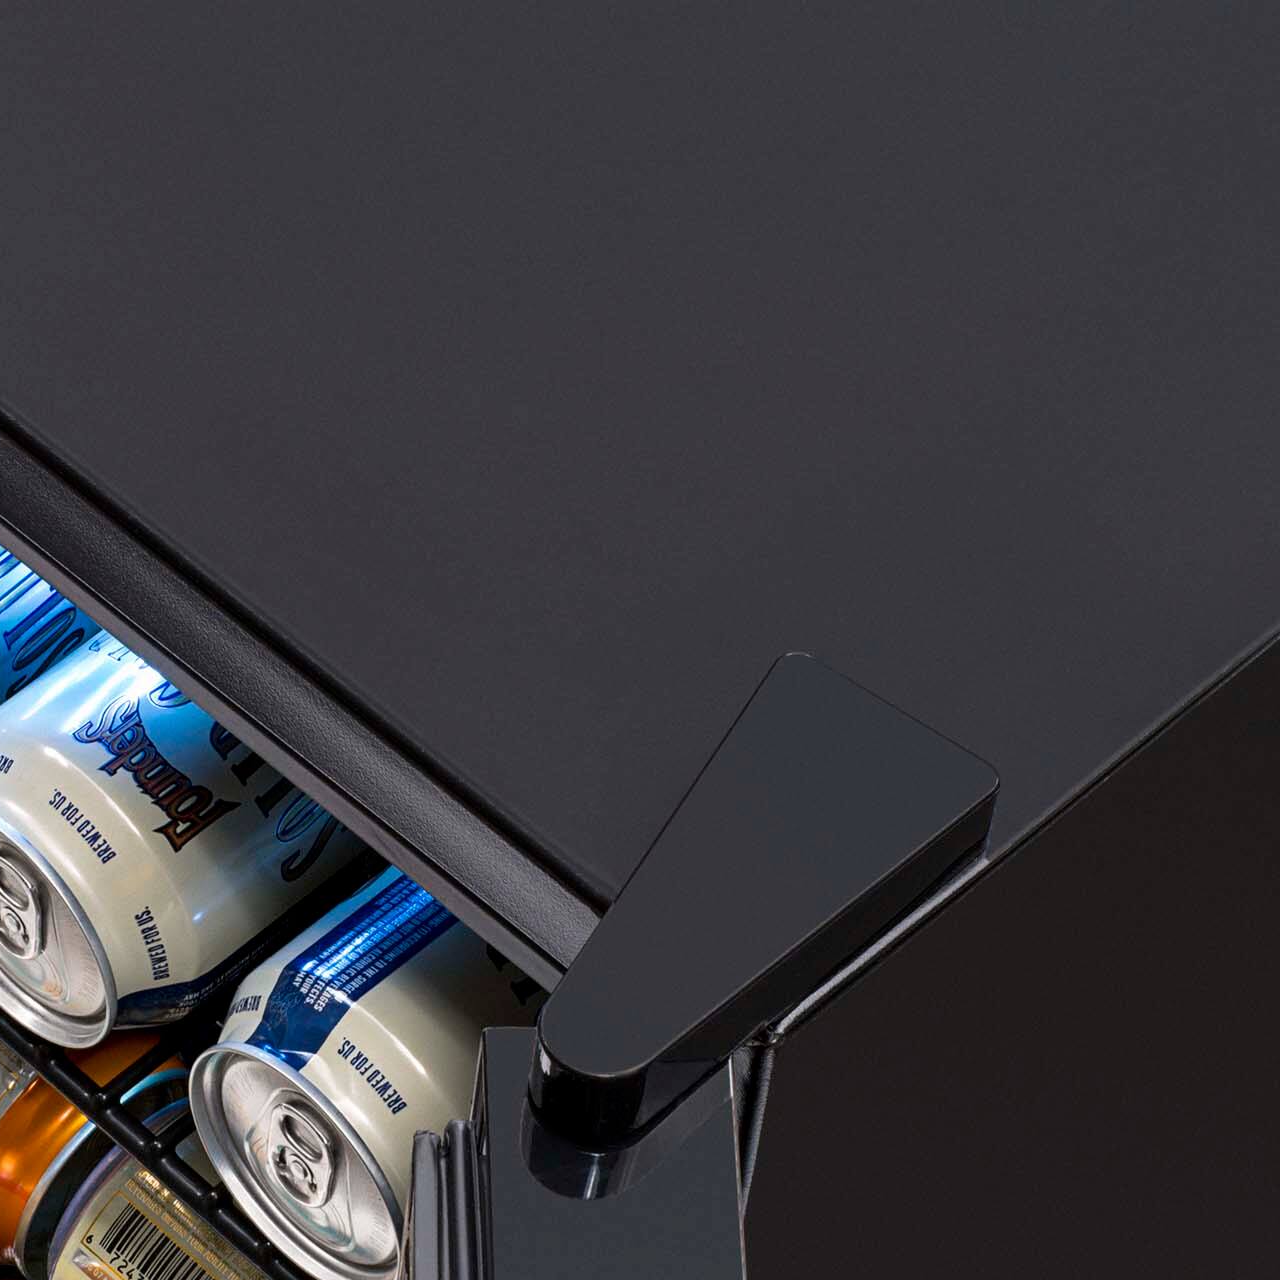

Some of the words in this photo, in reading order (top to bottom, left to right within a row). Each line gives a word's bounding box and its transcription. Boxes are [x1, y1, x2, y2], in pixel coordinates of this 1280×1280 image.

[49, 788, 69, 810] US.
[61, 802, 84, 826] FOR
[78, 818, 117, 864] BREWED
[135, 906, 154, 927] US.
[141, 925, 162, 946] FOR
[148, 940, 169, 980] BREWED
[337, 1037, 355, 1061] US.
[350, 1052, 374, 1076] FOR
[366, 1072, 407, 1114] BREWED
